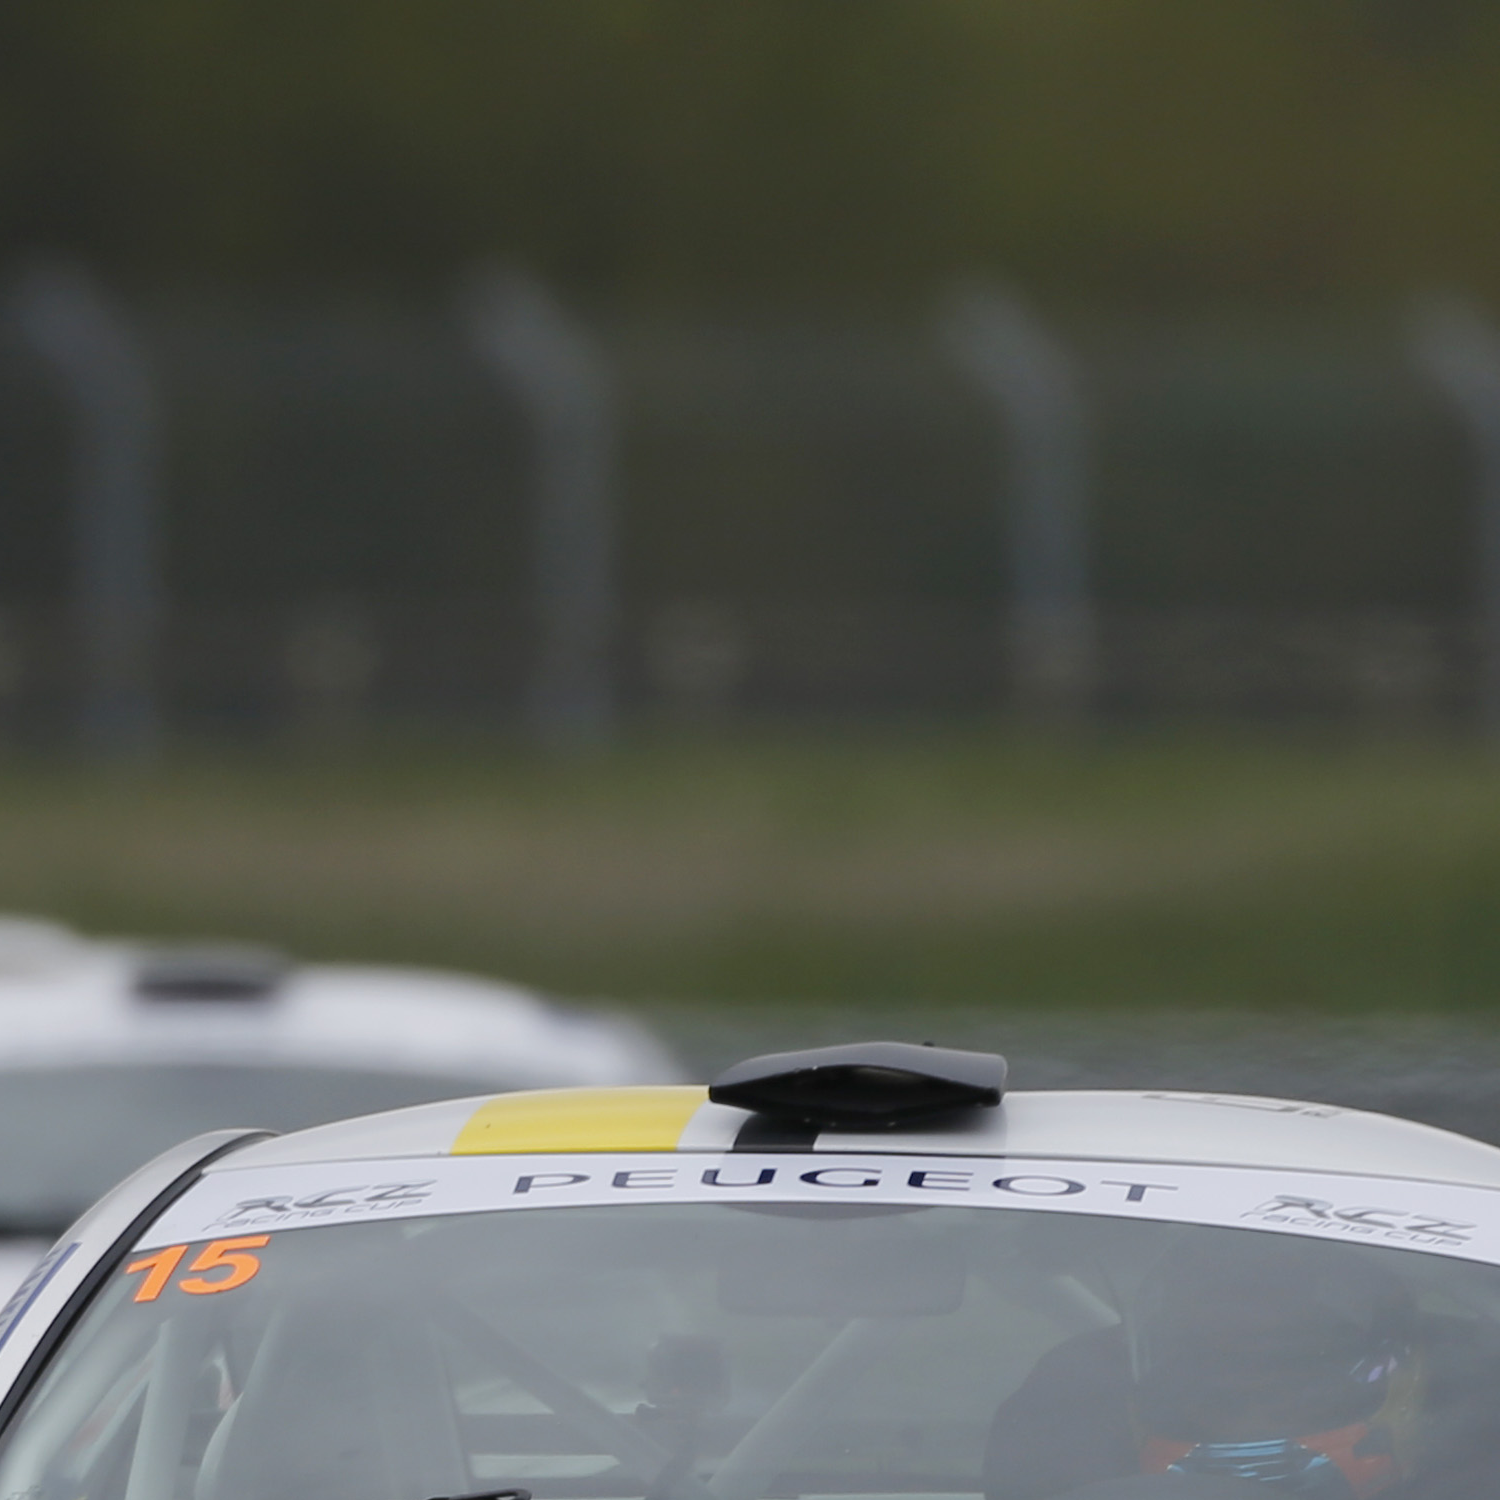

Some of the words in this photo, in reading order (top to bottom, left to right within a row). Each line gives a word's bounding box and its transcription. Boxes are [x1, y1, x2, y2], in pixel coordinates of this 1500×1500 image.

[216, 1179, 438, 1221] RCZ
[512, 1167, 1178, 1202] PEUGEOT
[1253, 1194, 1478, 1241] RCZ
[125, 1235, 271, 1303] 15
